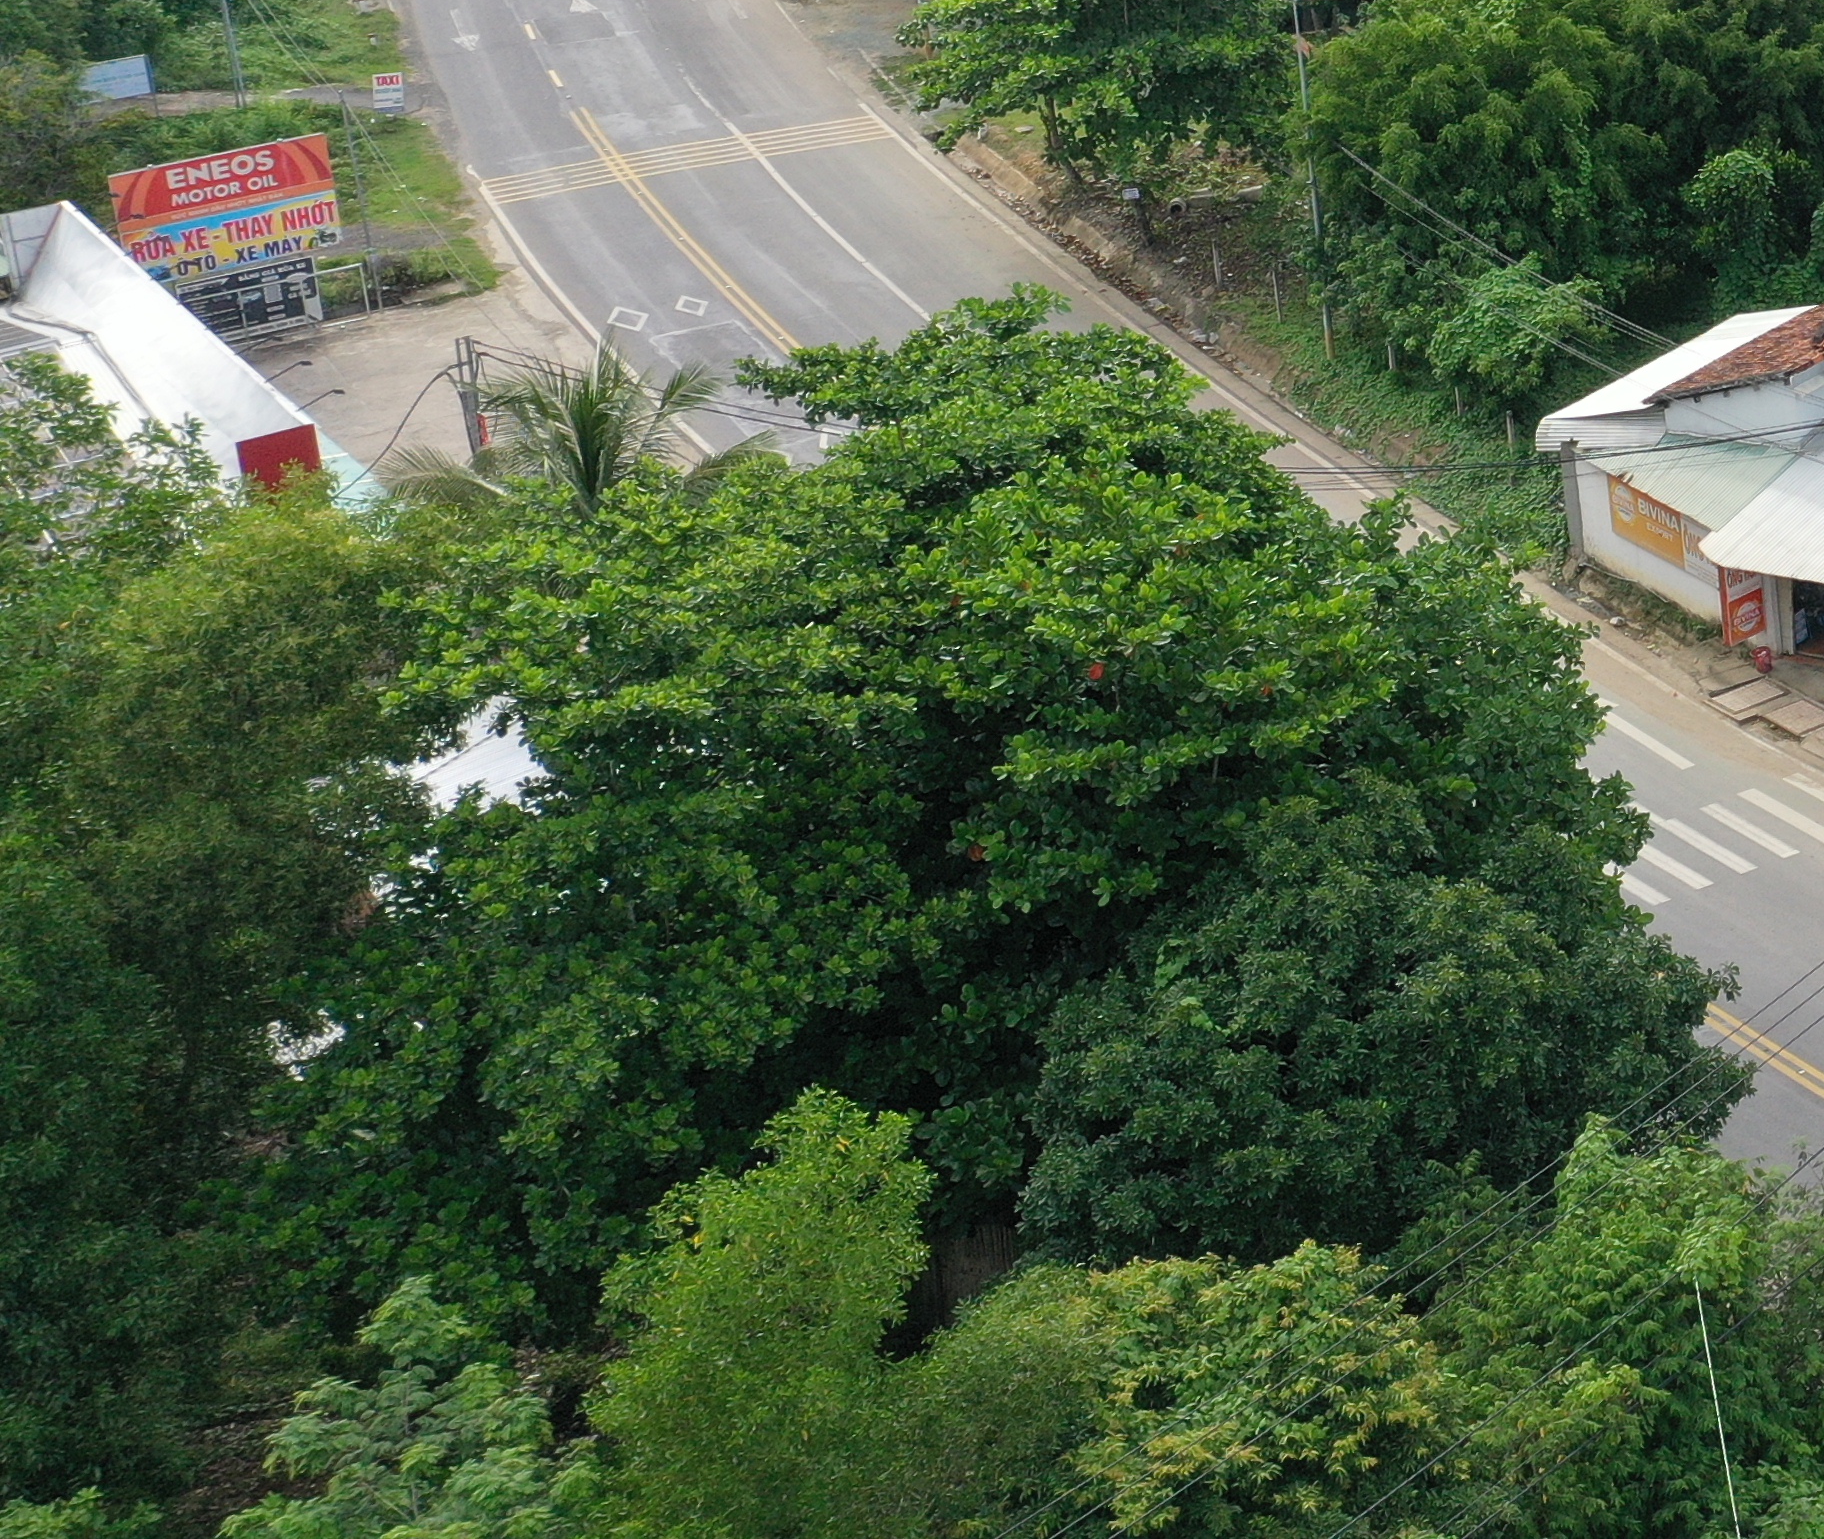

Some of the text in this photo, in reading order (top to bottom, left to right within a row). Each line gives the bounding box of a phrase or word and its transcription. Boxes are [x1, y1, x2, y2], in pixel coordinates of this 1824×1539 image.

[165, 150, 275, 190] ENEOS
[171, 175, 279, 207] MOTOR OIL
[179, 227, 210, 253] XE
[222, 213, 275, 244] THAY
[281, 199, 336, 232] NHỚT
[235, 245, 258, 265] XE
[1637, 497, 1680, 533] BIVINA
